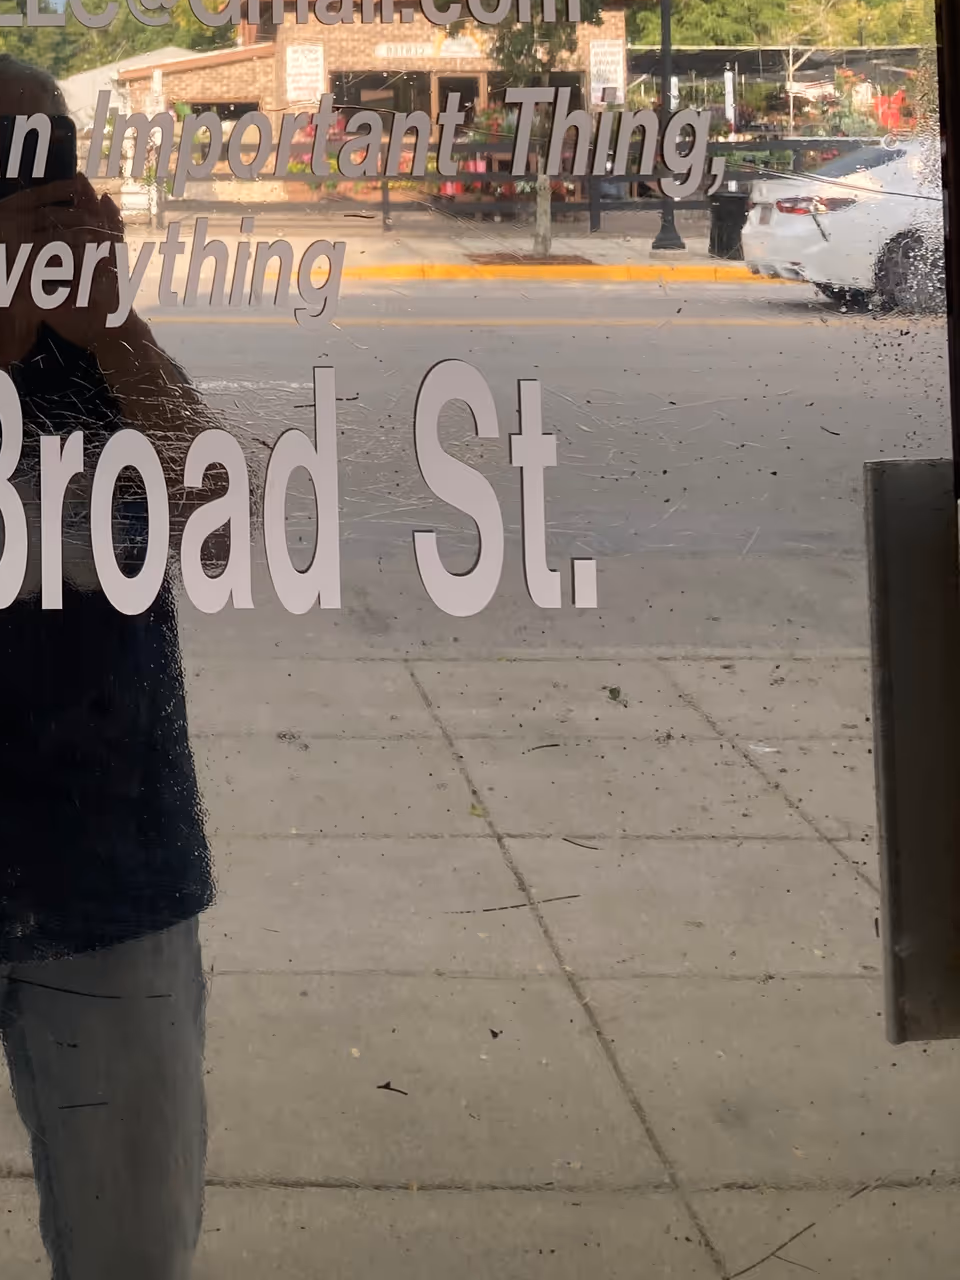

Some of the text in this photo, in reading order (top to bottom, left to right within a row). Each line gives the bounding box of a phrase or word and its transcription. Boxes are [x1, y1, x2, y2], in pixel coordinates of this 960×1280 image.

[85, 89, 465, 197] Important
[503, 86, 726, 199] Thing,
[412, 358, 597, 616] St.
